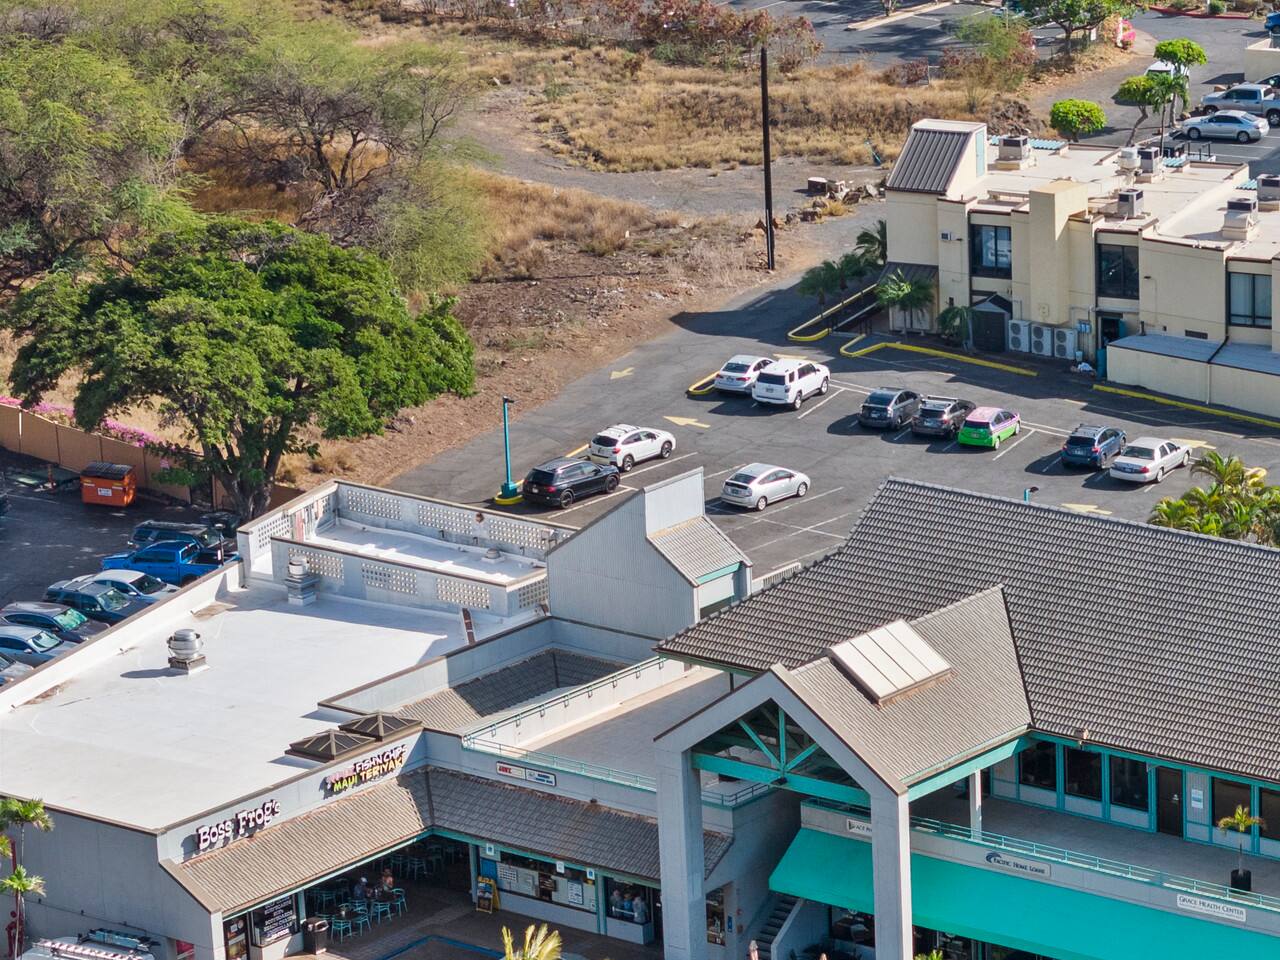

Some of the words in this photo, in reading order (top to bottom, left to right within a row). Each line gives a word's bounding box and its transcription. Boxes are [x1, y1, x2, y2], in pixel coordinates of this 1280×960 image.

[333, 772, 358, 792] MAUI
[360, 754, 404, 781] TERIYAKI
[1180, 895, 1198, 905] GRACE
[1200, 900, 1220, 910] HEALTH
[1221, 905, 1244, 916] CENTER
